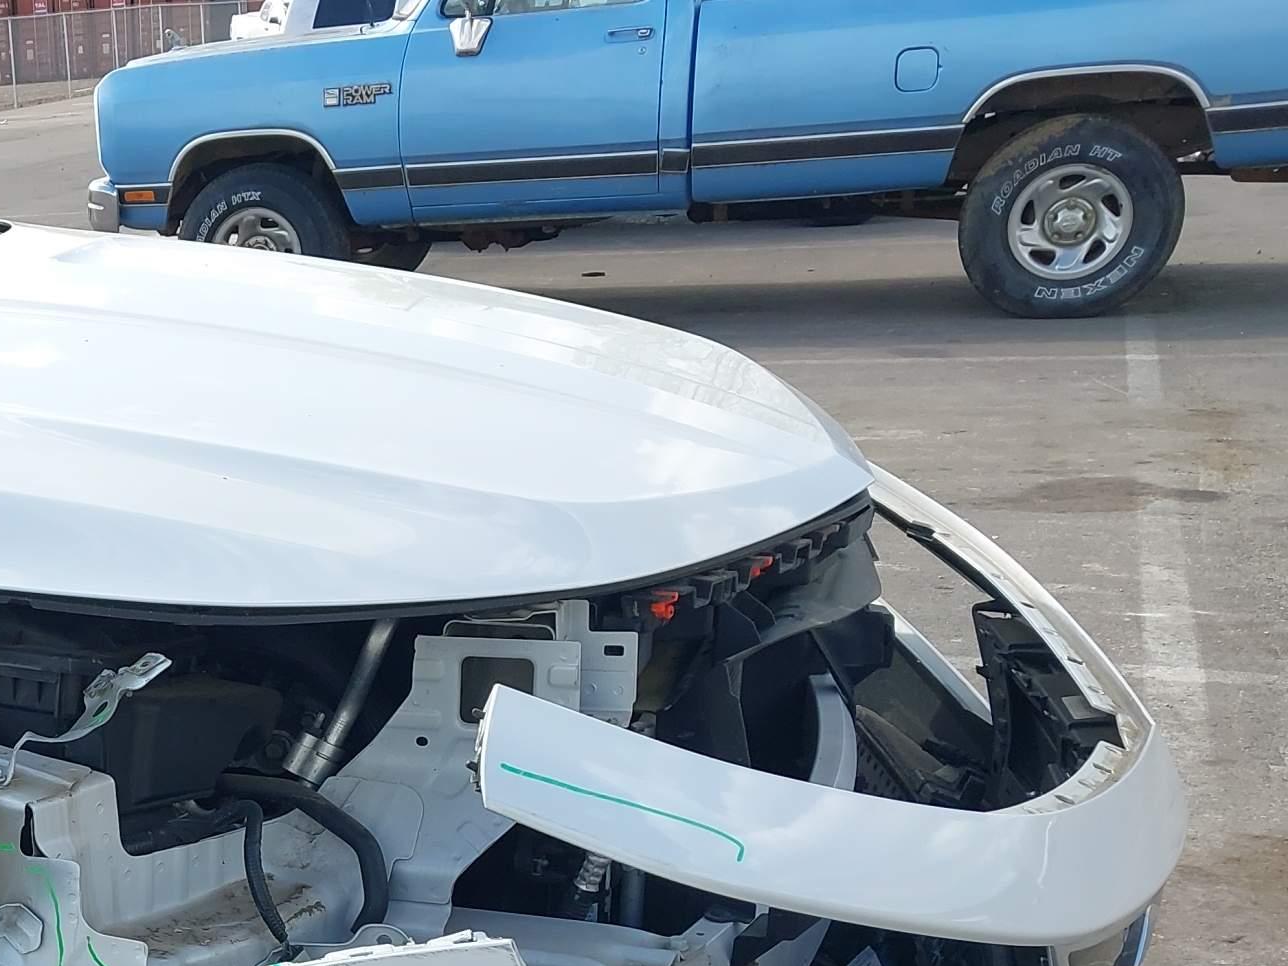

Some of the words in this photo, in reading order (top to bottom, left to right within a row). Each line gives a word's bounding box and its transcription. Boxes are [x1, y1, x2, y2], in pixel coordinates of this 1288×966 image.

[343, 84, 391, 97] POWER
[343, 95, 376, 105] RAM
[991, 144, 1081, 216] ROADIAN
[1089, 145, 1123, 162] HT
[196, 199, 228, 242] ADIAN
[1034, 246, 1145, 299] NEXEN
